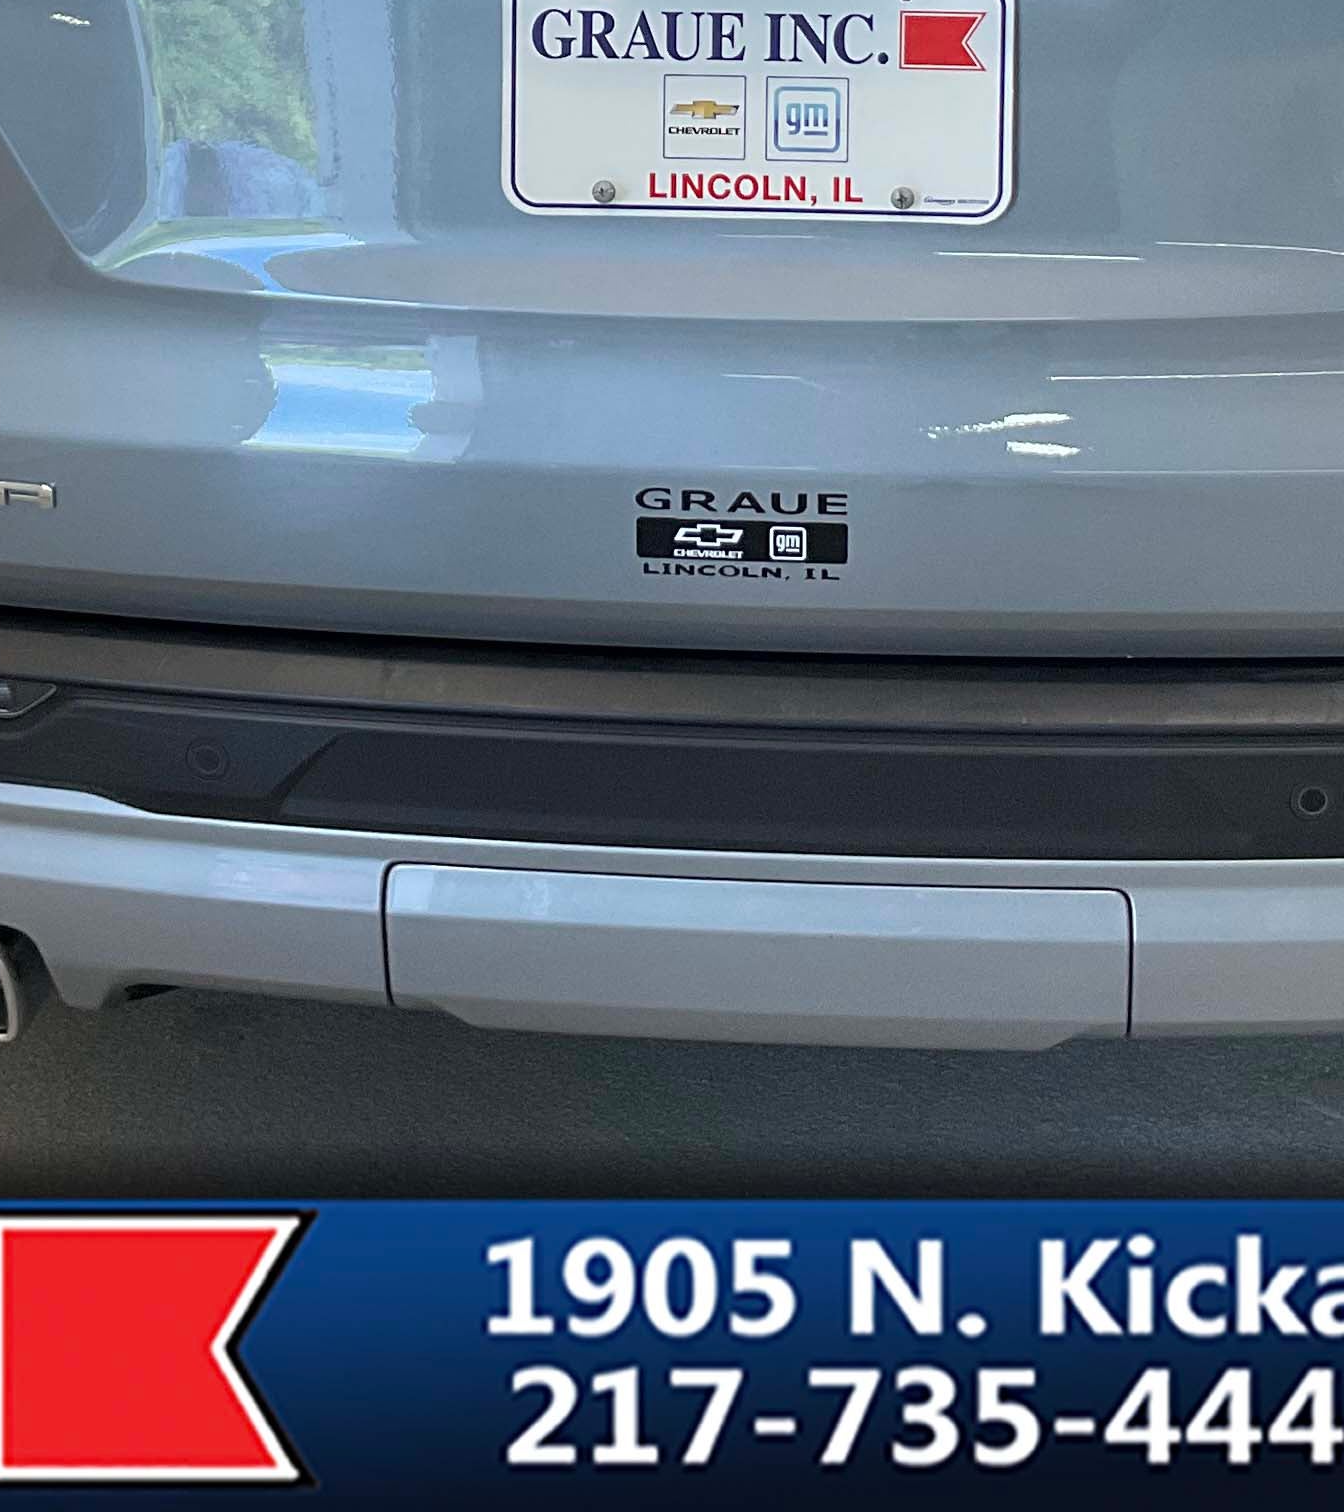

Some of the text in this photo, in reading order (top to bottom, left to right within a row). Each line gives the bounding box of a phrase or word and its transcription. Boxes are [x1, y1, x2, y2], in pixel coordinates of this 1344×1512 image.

[531, 8, 889, 65] GRAUE INC.
[667, 125, 741, 137] CHEVROLET
[785, 102, 829, 137] gm
[649, 172, 864, 206] LINCOLN, IL
[635, 487, 848, 515] GRAUE
[673, 548, 744, 560] CHEVROLET
[775, 534, 800, 553] gm
[643, 562, 840, 581] LINCOLN, IL
